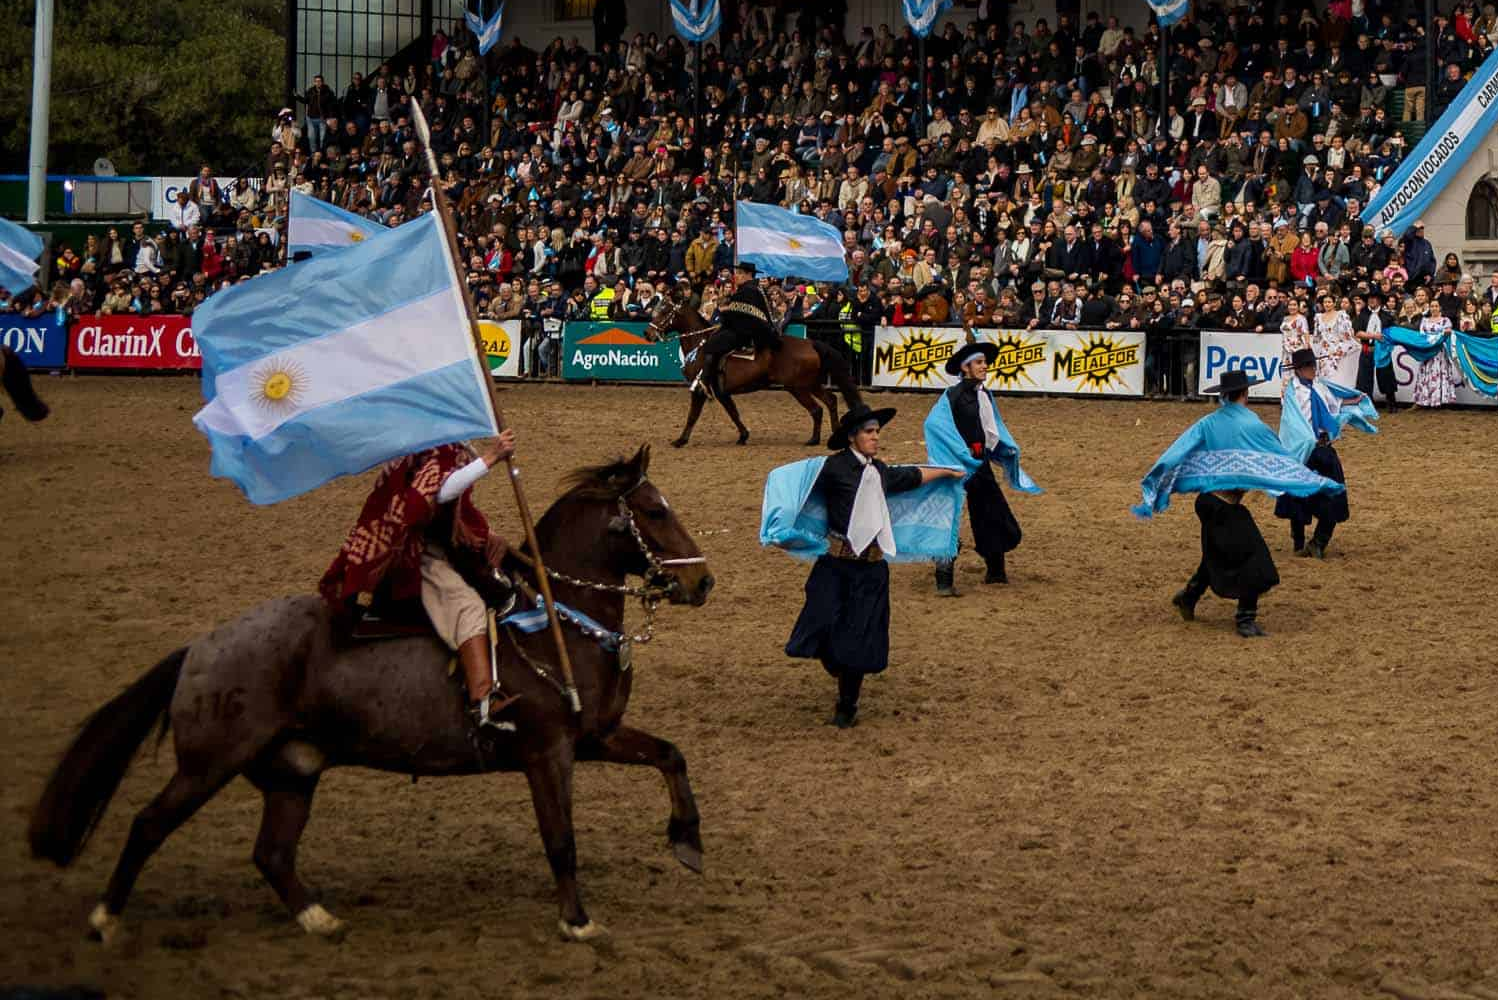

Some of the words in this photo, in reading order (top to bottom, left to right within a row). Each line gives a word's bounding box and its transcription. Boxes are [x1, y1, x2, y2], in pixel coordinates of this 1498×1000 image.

[1380, 131, 1461, 225] AUTOCONVOCADOS
[0, 327, 48, 353] ON
[572, 349, 659, 369] AgroNación
[874, 343, 954, 376] METALFOR
[1053, 348, 1137, 381] METALFOR
